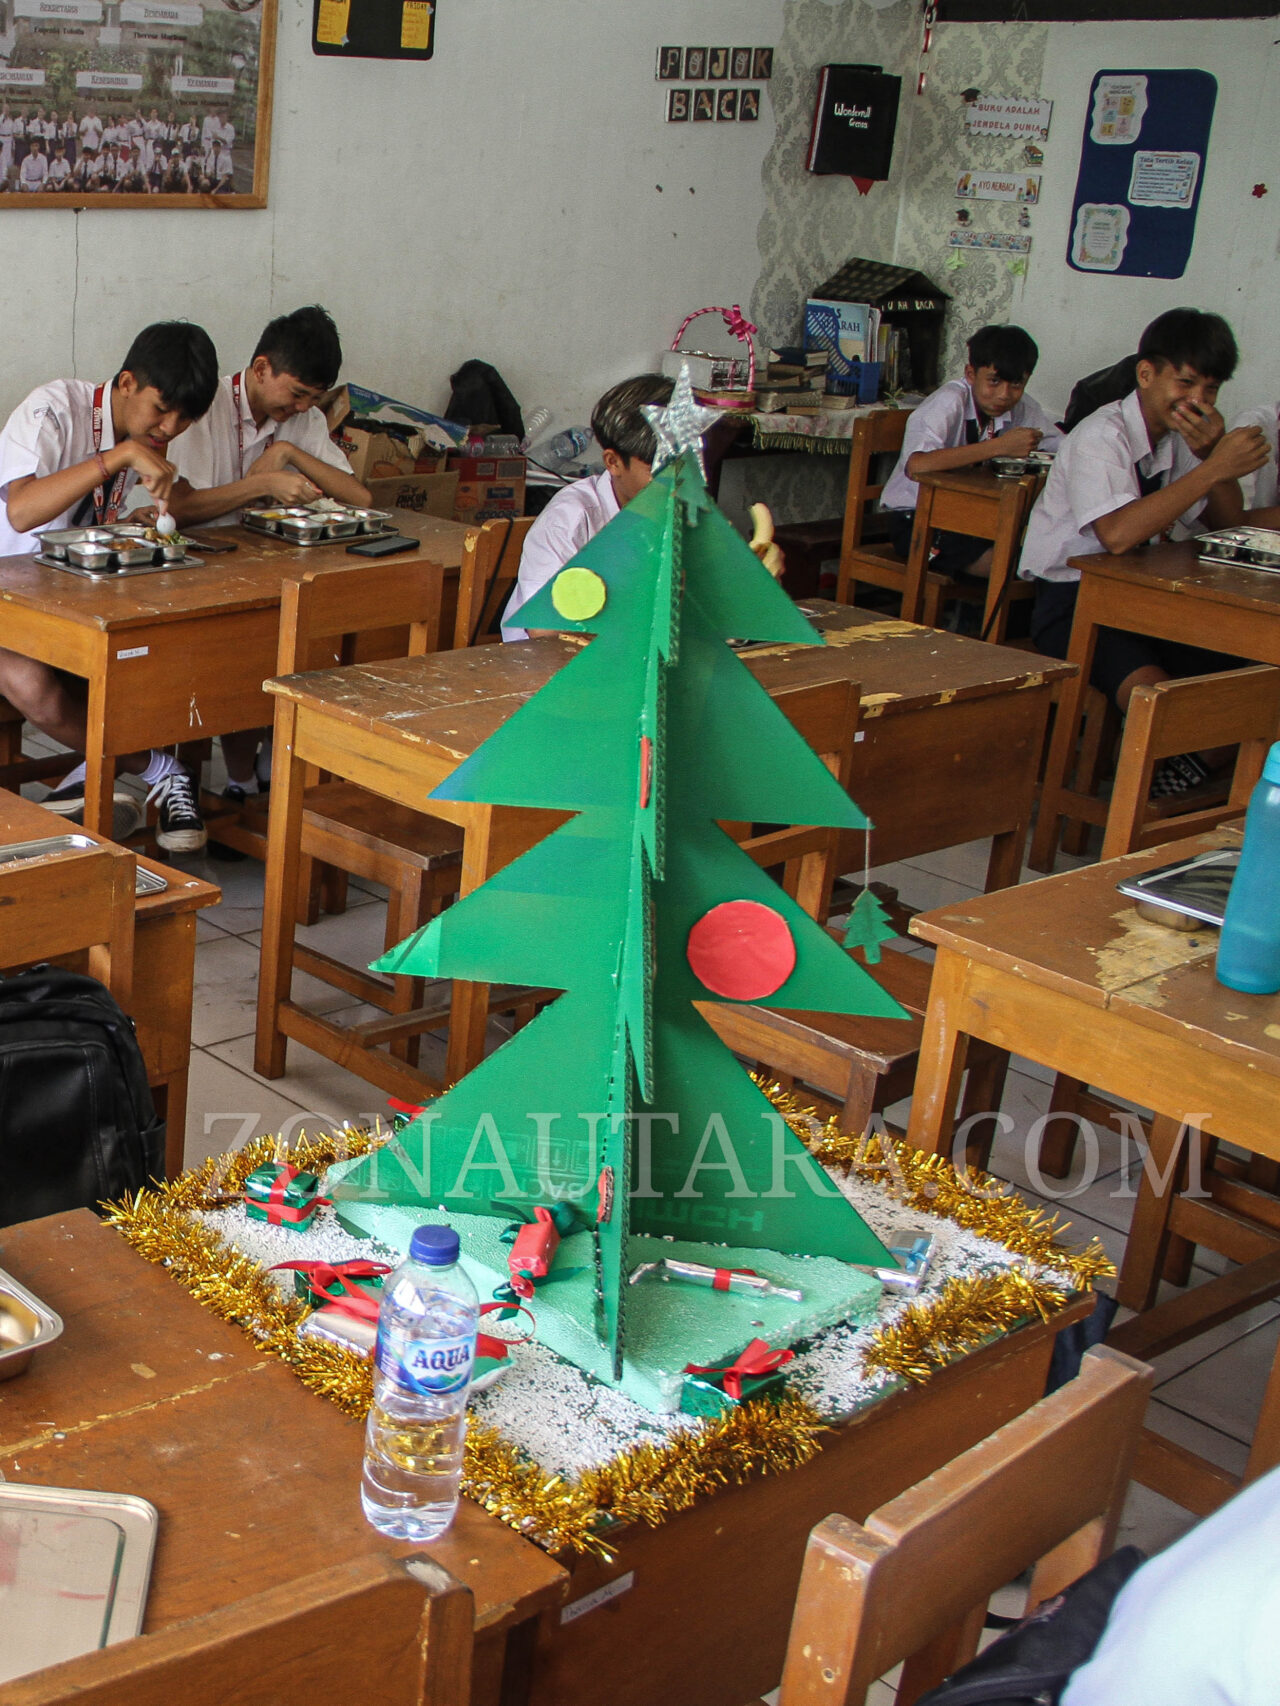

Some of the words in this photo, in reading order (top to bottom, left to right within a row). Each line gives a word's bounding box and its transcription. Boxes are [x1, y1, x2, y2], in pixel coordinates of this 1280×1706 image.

[669, 90, 759, 120] BACA
[978, 103, 1002, 112] BUKU
[1005, 106, 1040, 115] ADALAH
[972, 120, 1010, 130] JENDELA
[1013, 122, 1041, 132] DUNIA
[978, 180, 991, 191] AYO
[991, 182, 1016, 193] MEMBACA
[412, 1344, 470, 1371] AQUA
